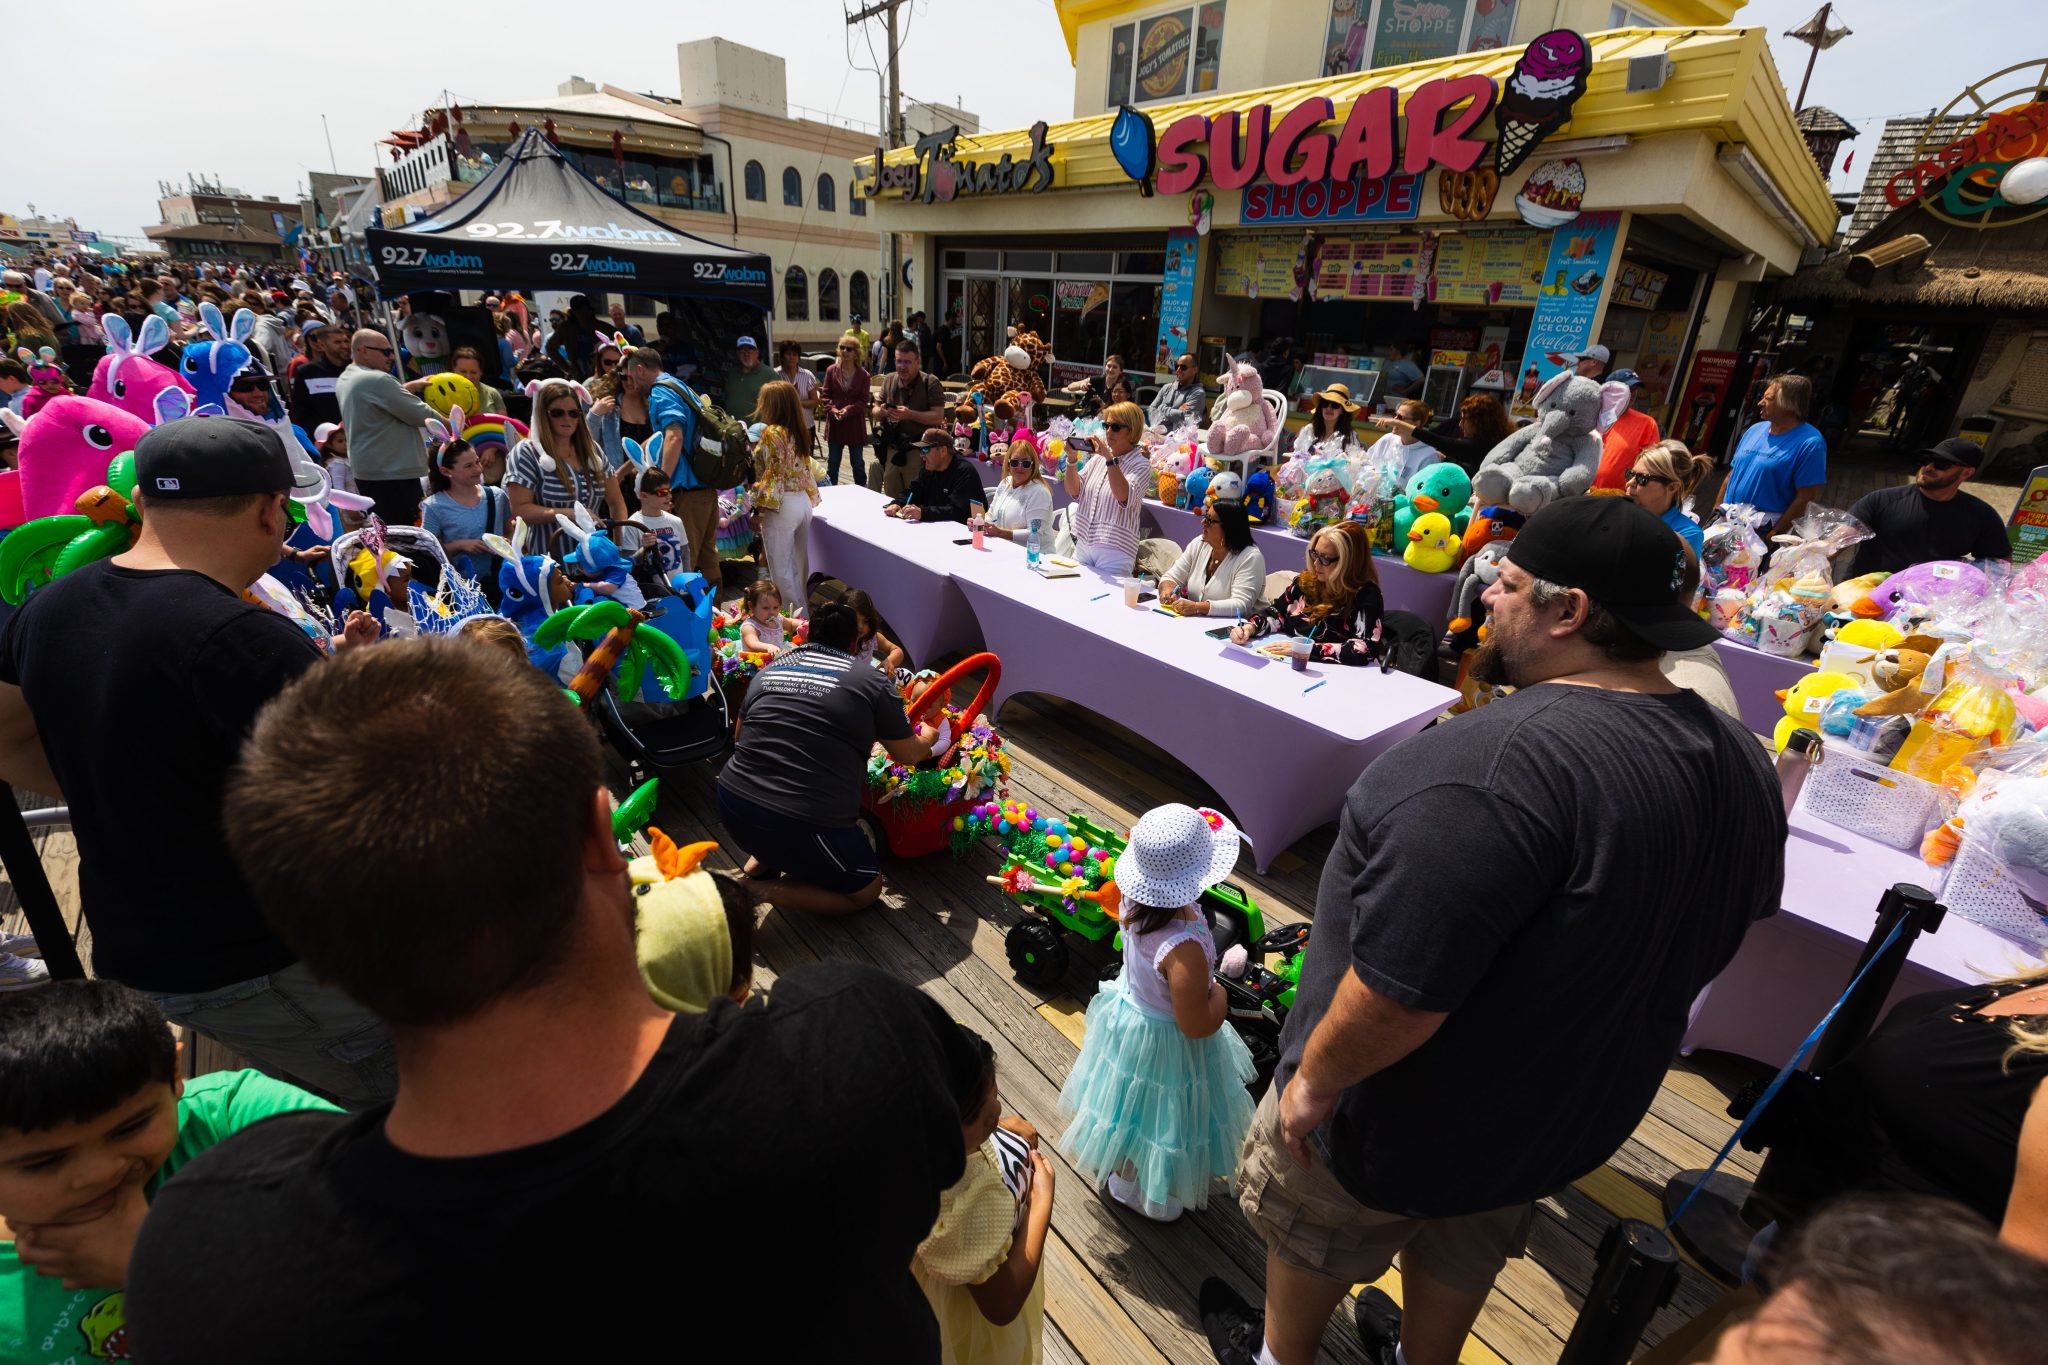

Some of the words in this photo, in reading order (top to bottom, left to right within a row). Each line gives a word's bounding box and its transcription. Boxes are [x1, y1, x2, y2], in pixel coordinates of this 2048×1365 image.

[1384, 17, 1456, 33] SHOPPE
[1158, 33, 1191, 65] TOMATOES
[1156, 74, 1499, 195] SUGAR
[864, 147, 920, 200] Joey
[1245, 174, 1411, 220] SHOPPE
[1538, 315, 1570, 324] ENJOY
[1572, 316, 1587, 324] AN
[1538, 323, 1552, 332] ICE
[1555, 324, 1583, 333] COLD
[820, 645, 856, 660] PEACEMAKERS
[808, 684, 831, 694] CALLED
